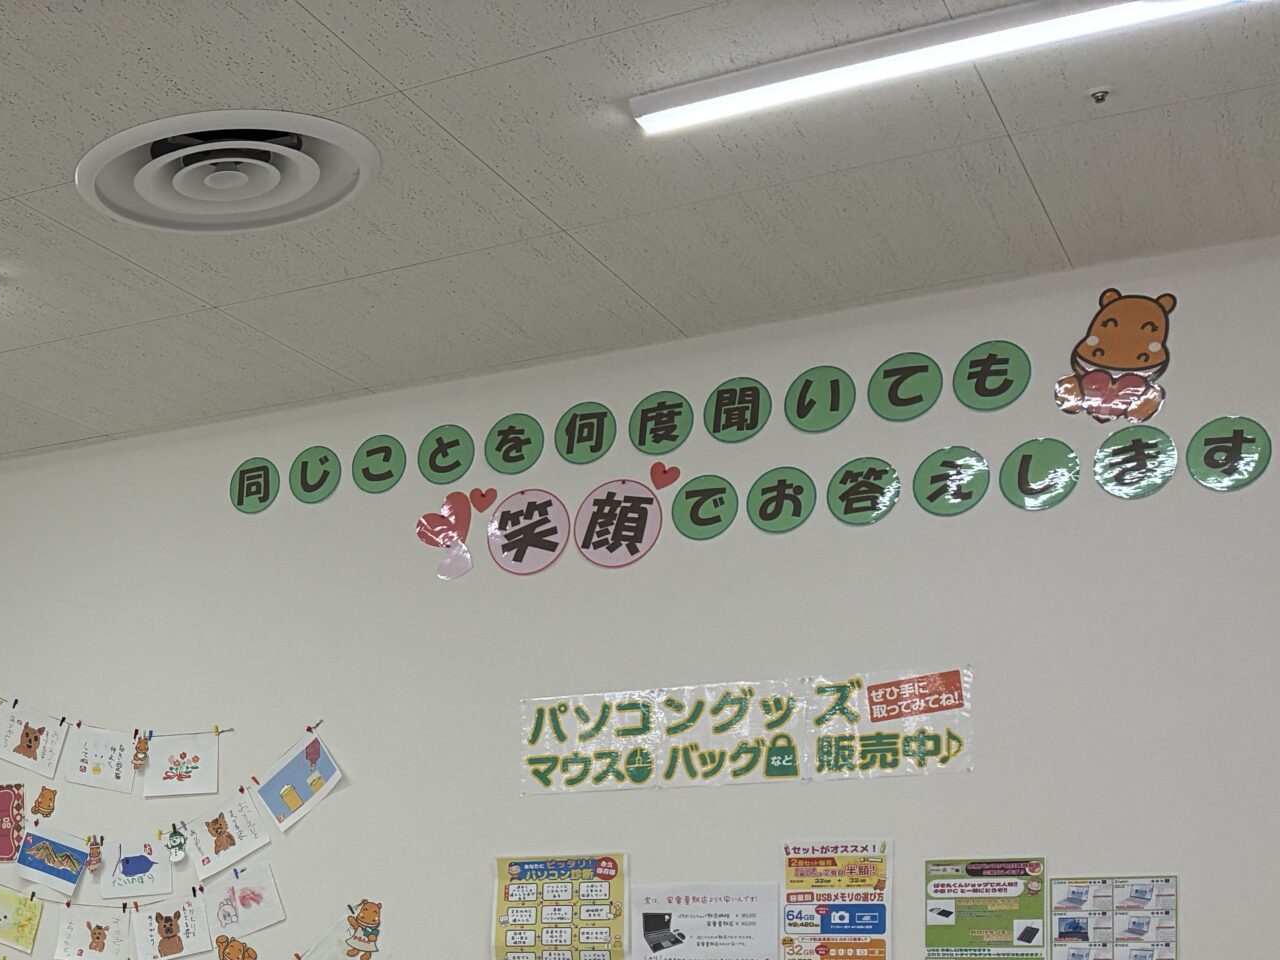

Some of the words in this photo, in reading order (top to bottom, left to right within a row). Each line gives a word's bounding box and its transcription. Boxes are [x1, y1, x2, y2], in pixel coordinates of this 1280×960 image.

[237, 353, 1014, 506] 同じことを何度聞いても
[497, 429, 1256, 563] 笑顔でお答えします
[527, 678, 864, 745] パソコングッズ
[871, 681, 928, 702] ぜひ手に
[527, 747, 625, 788] マウス
[662, 741, 766, 782] バッグ
[770, 754, 793, 767] など
[815, 727, 941, 773] 販売中
[786, 910, 815, 920] 64GB
[787, 945, 814, 955] 32GB
